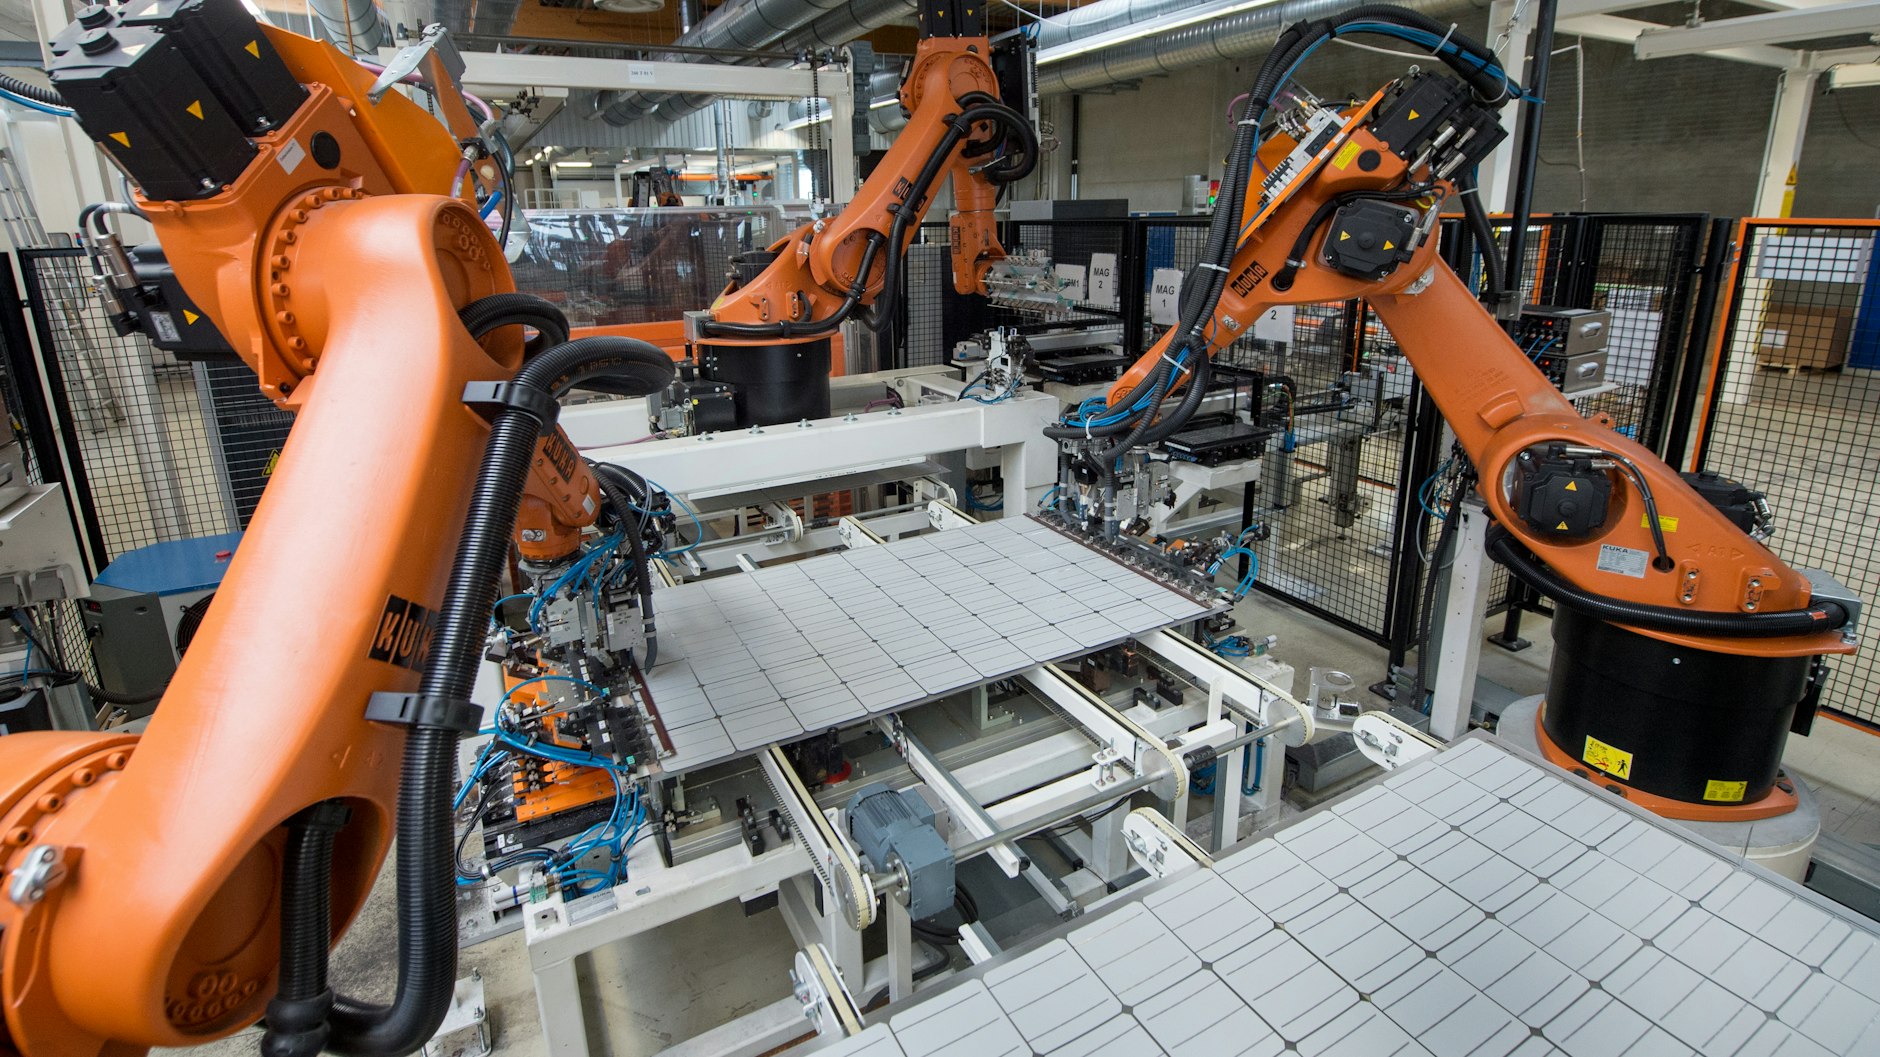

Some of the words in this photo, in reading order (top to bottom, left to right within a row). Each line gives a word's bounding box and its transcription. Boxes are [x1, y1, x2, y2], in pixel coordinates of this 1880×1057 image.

[1093, 267, 1110, 277] MAG
[1098, 280, 1103, 289] 2
[1232, 262, 1268, 297] KUKA
[1155, 284, 1175, 295] MAG
[1161, 299, 1166, 308] 1
[1270, 309, 1277, 321] 2
[545, 431, 576, 478] KUKA
[1602, 544, 1629, 554] KUKA
